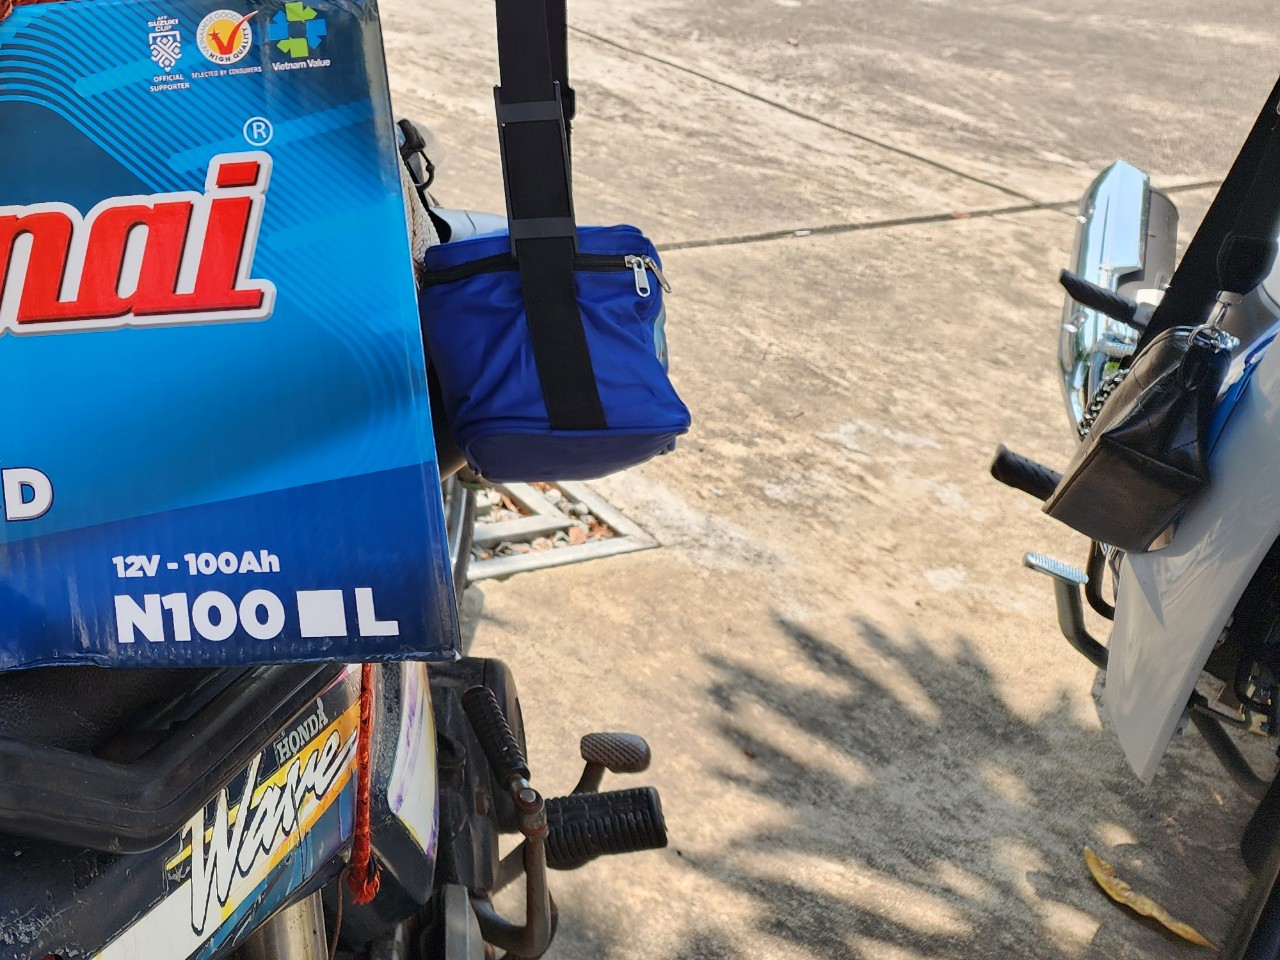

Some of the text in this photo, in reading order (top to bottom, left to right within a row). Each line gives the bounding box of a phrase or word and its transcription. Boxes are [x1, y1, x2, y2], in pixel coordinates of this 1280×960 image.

[148, 18, 179, 28] SUZUKI
[209, 27, 250, 63] HIGH QUALITY
[191, 66, 263, 79] SELECTED BY CONSUMERS
[272, 58, 331, 71] Vietnam Value
[149, 82, 191, 93] SUPPORTER
[153, 73, 185, 83] OFFICIAL
[112, 554, 160, 578] 12V
[184, 550, 281, 576] 100Ah
[114, 589, 286, 644] N100
[276, 708, 329, 762] HONDA
[181, 729, 358, 936] Wave
